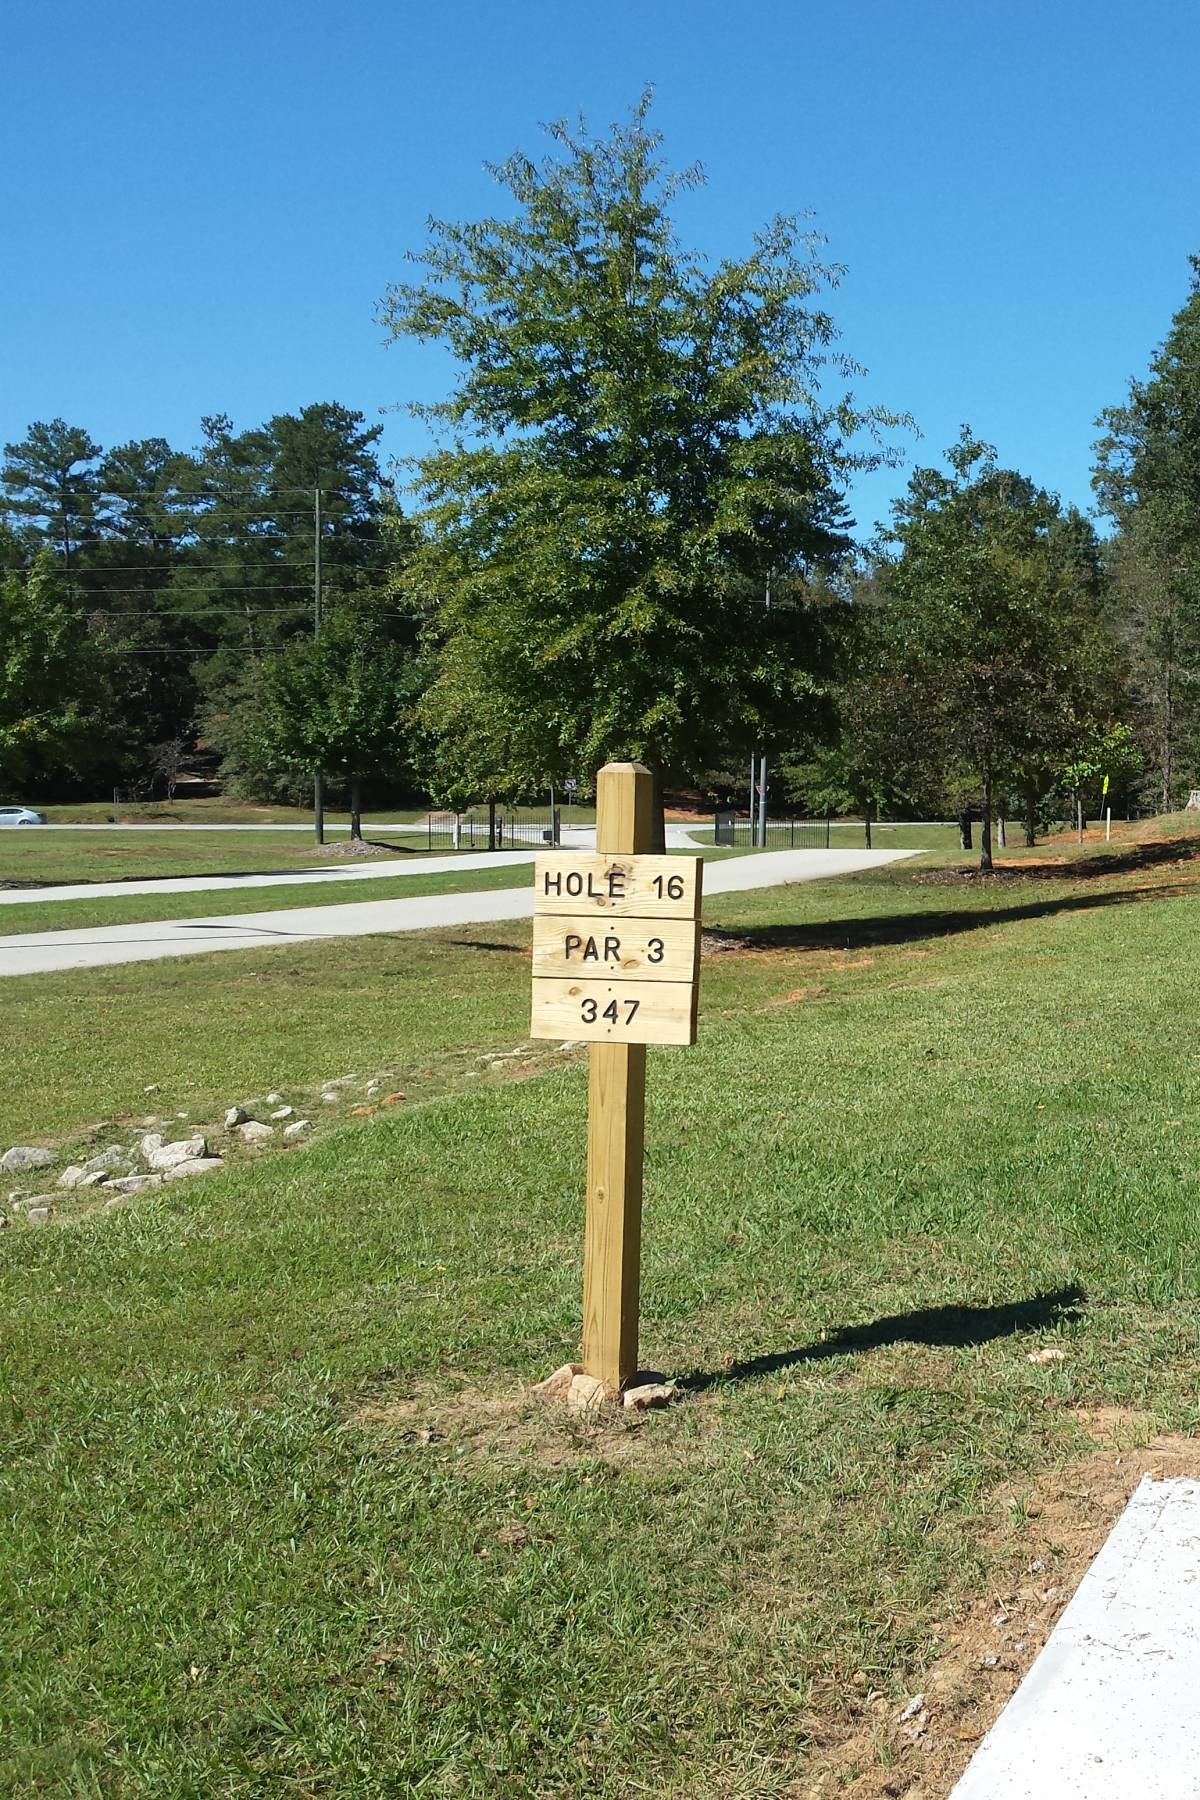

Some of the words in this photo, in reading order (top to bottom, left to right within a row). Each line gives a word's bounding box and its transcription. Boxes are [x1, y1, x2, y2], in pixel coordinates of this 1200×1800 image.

[544, 871, 626, 898] HOLE
[652, 874, 685, 900] 16
[564, 934, 621, 962] PAR
[646, 937, 665, 964] 3
[580, 998, 640, 1025] 347
